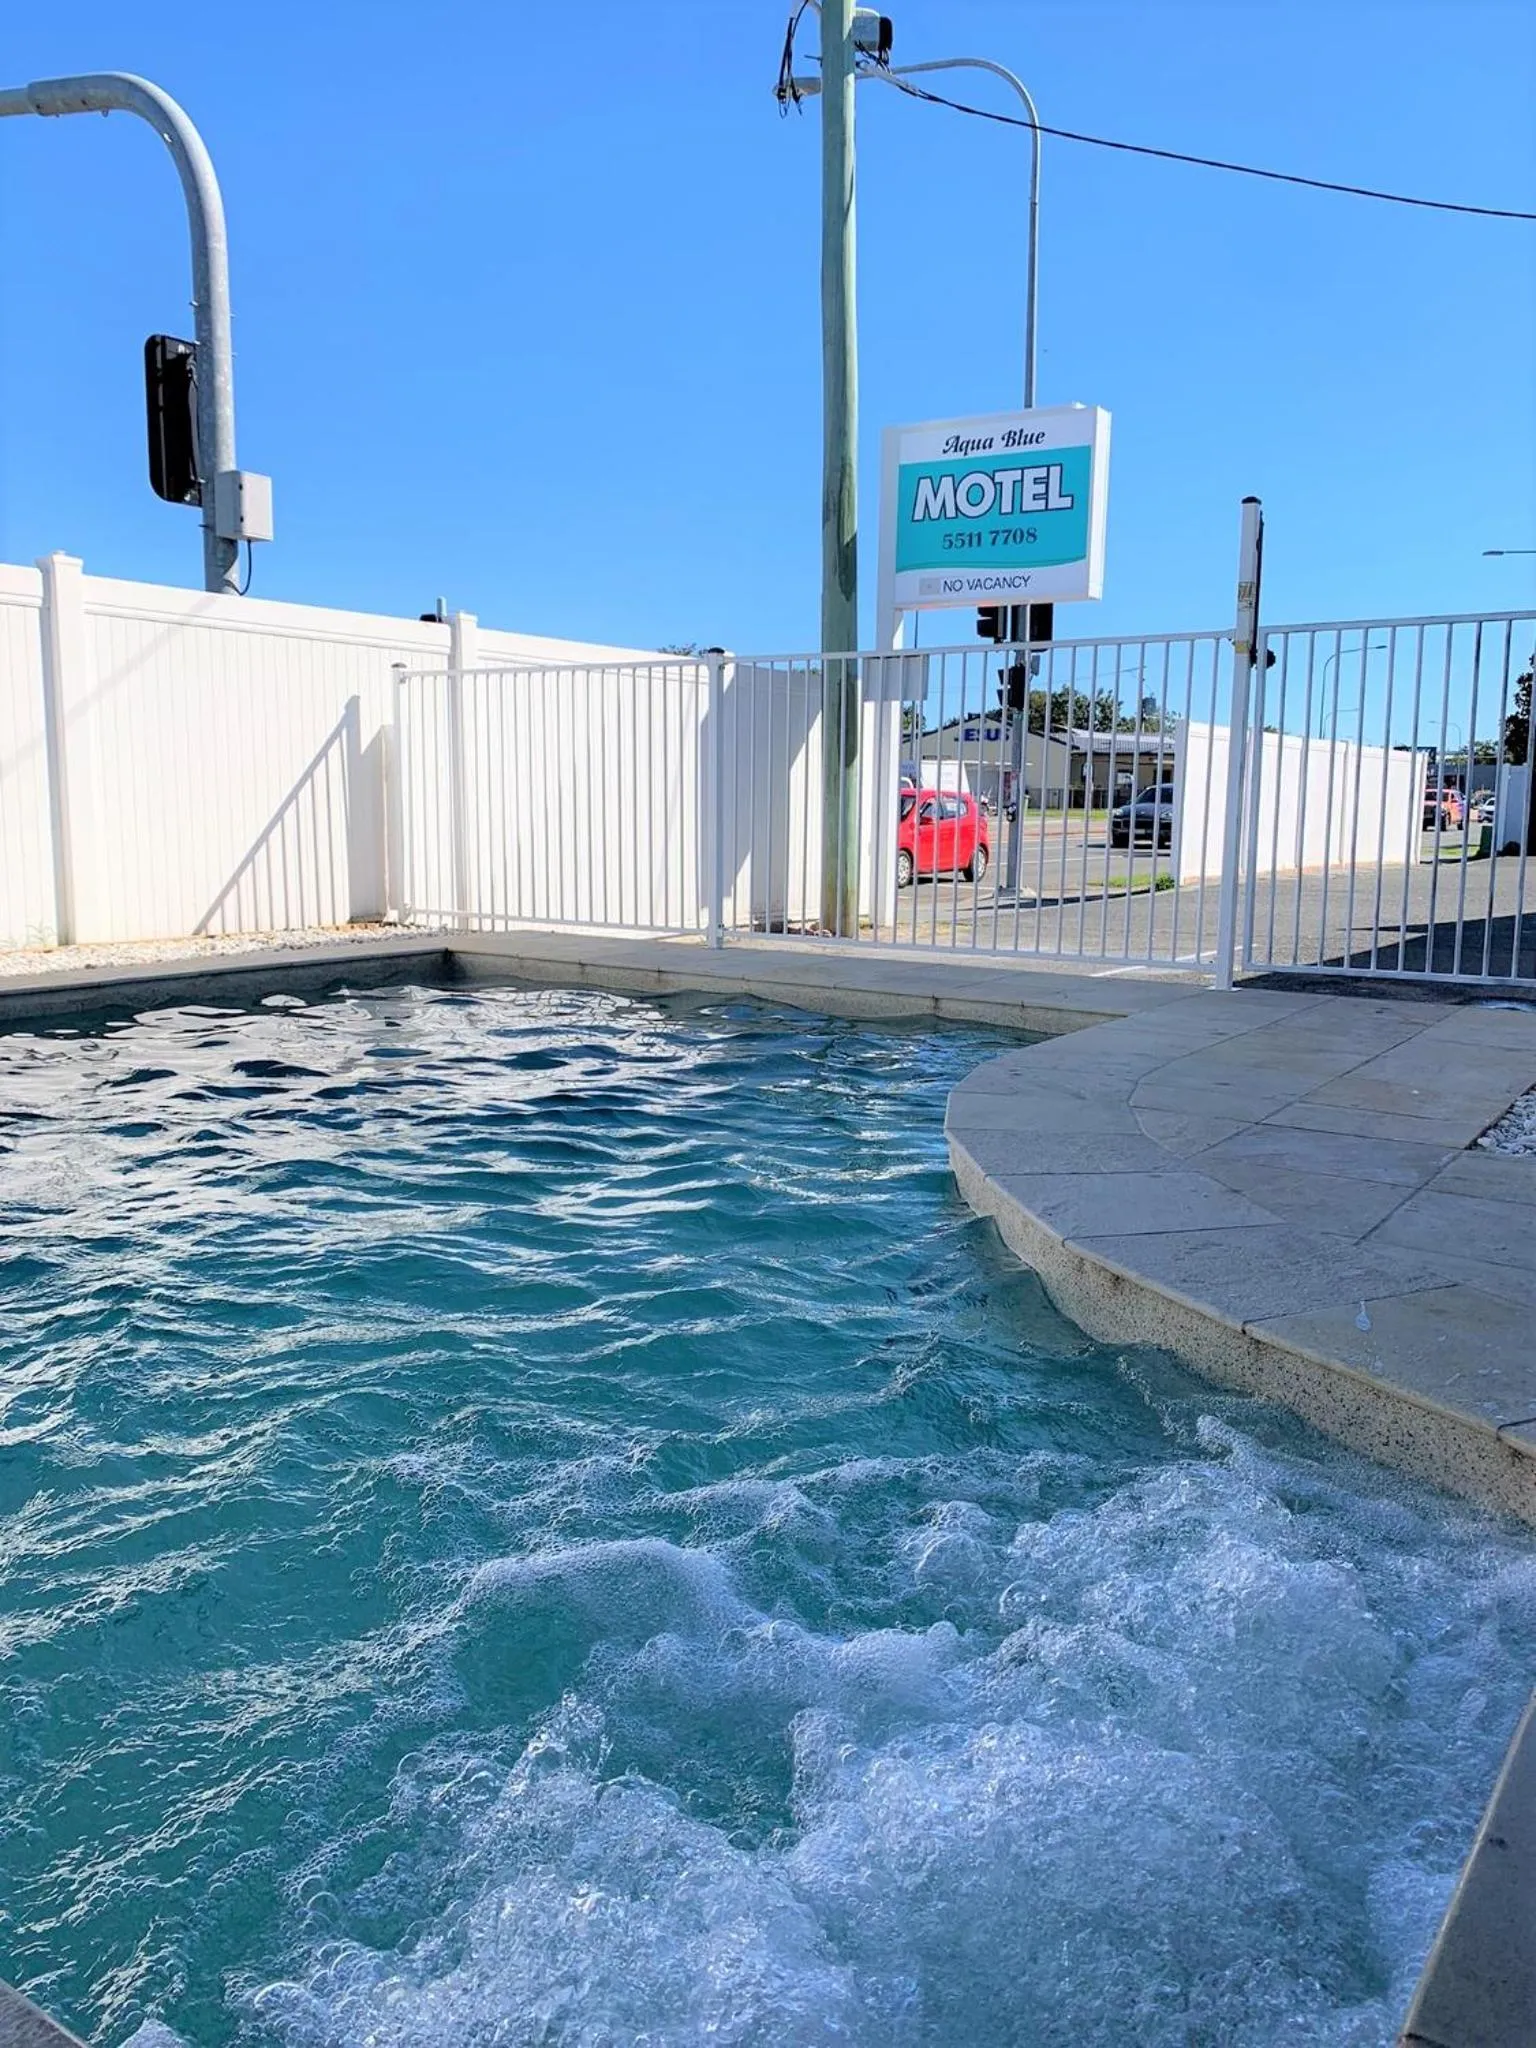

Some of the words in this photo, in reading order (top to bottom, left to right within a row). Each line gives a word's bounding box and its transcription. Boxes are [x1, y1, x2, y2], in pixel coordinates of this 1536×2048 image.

[942, 434, 994, 456] Aqua
[1001, 428, 1045, 448] Blue
[912, 463, 1074, 522] MOTEL
[943, 531, 982, 550] 5511
[989, 527, 1038, 545] 7708
[943, 580, 963, 593] NO
[966, 575, 1031, 591] VACANCY
